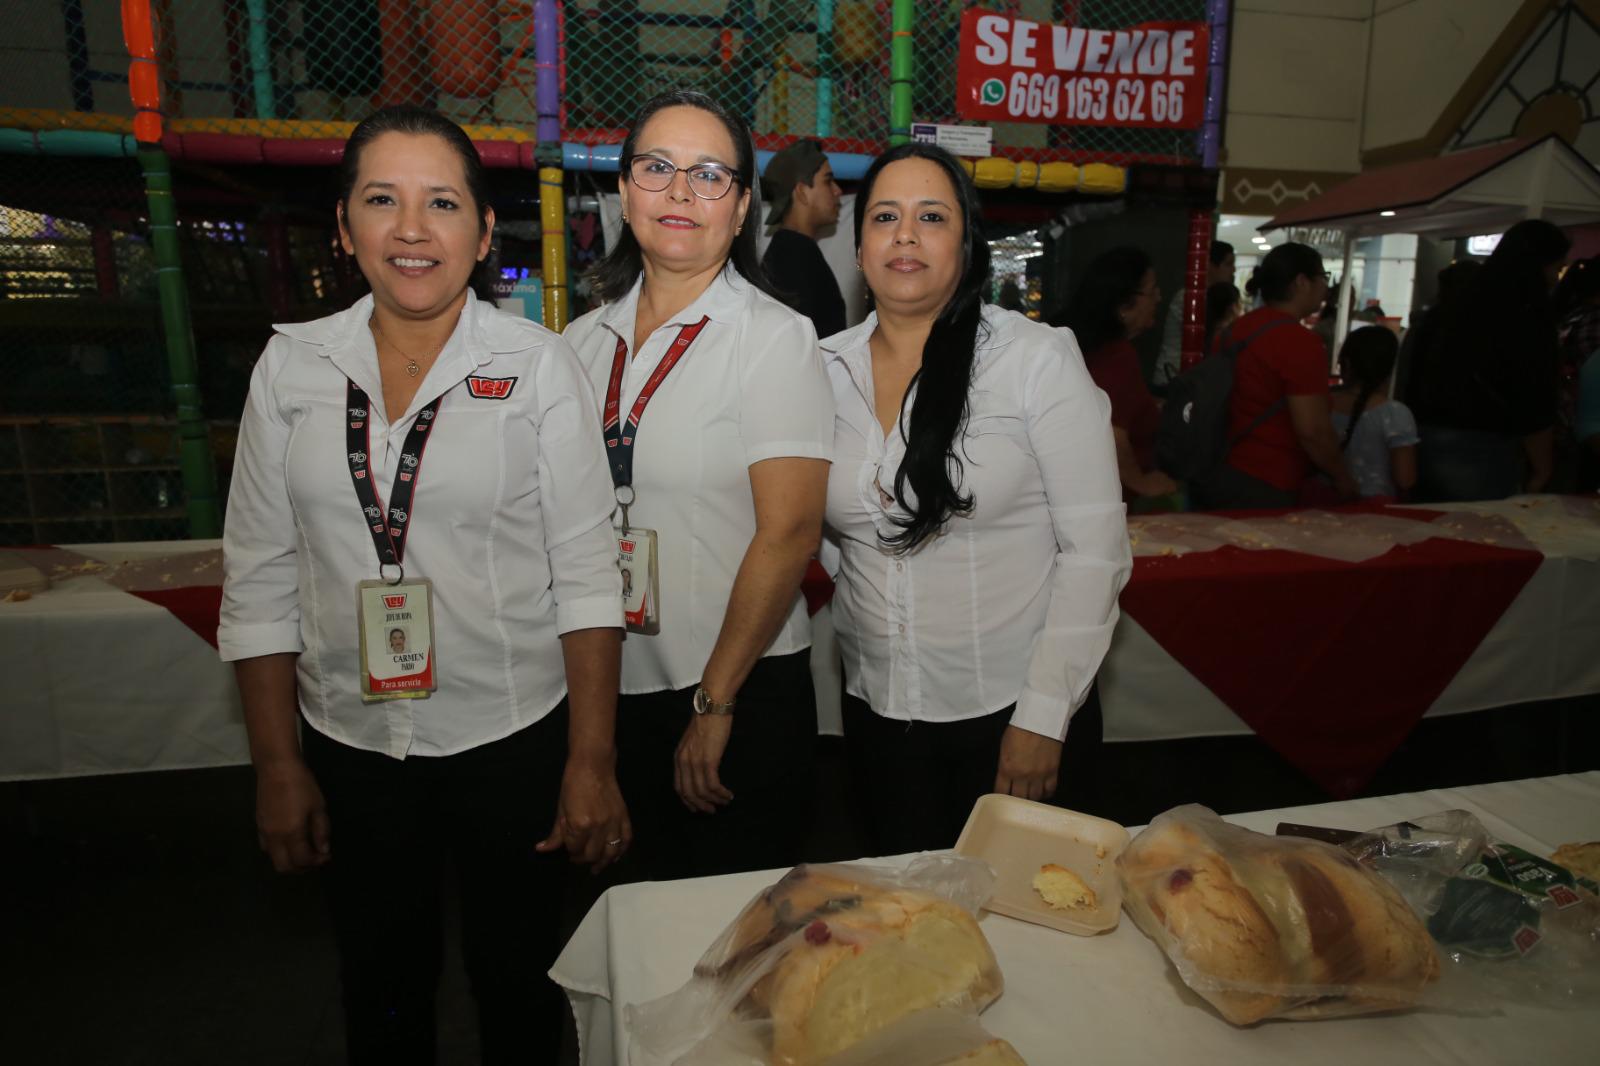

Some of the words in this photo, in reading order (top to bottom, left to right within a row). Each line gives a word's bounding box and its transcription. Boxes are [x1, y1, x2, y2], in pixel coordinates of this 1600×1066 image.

[975, 15, 1039, 68] SE
[1052, 25, 1195, 75] VENDE
[1008, 71, 1060, 118] 669
[1064, 77, 1109, 120] 163
[1113, 79, 1145, 121] 62
[1151, 81, 1184, 122] 66
[393, 652, 424, 663] CARMEN
